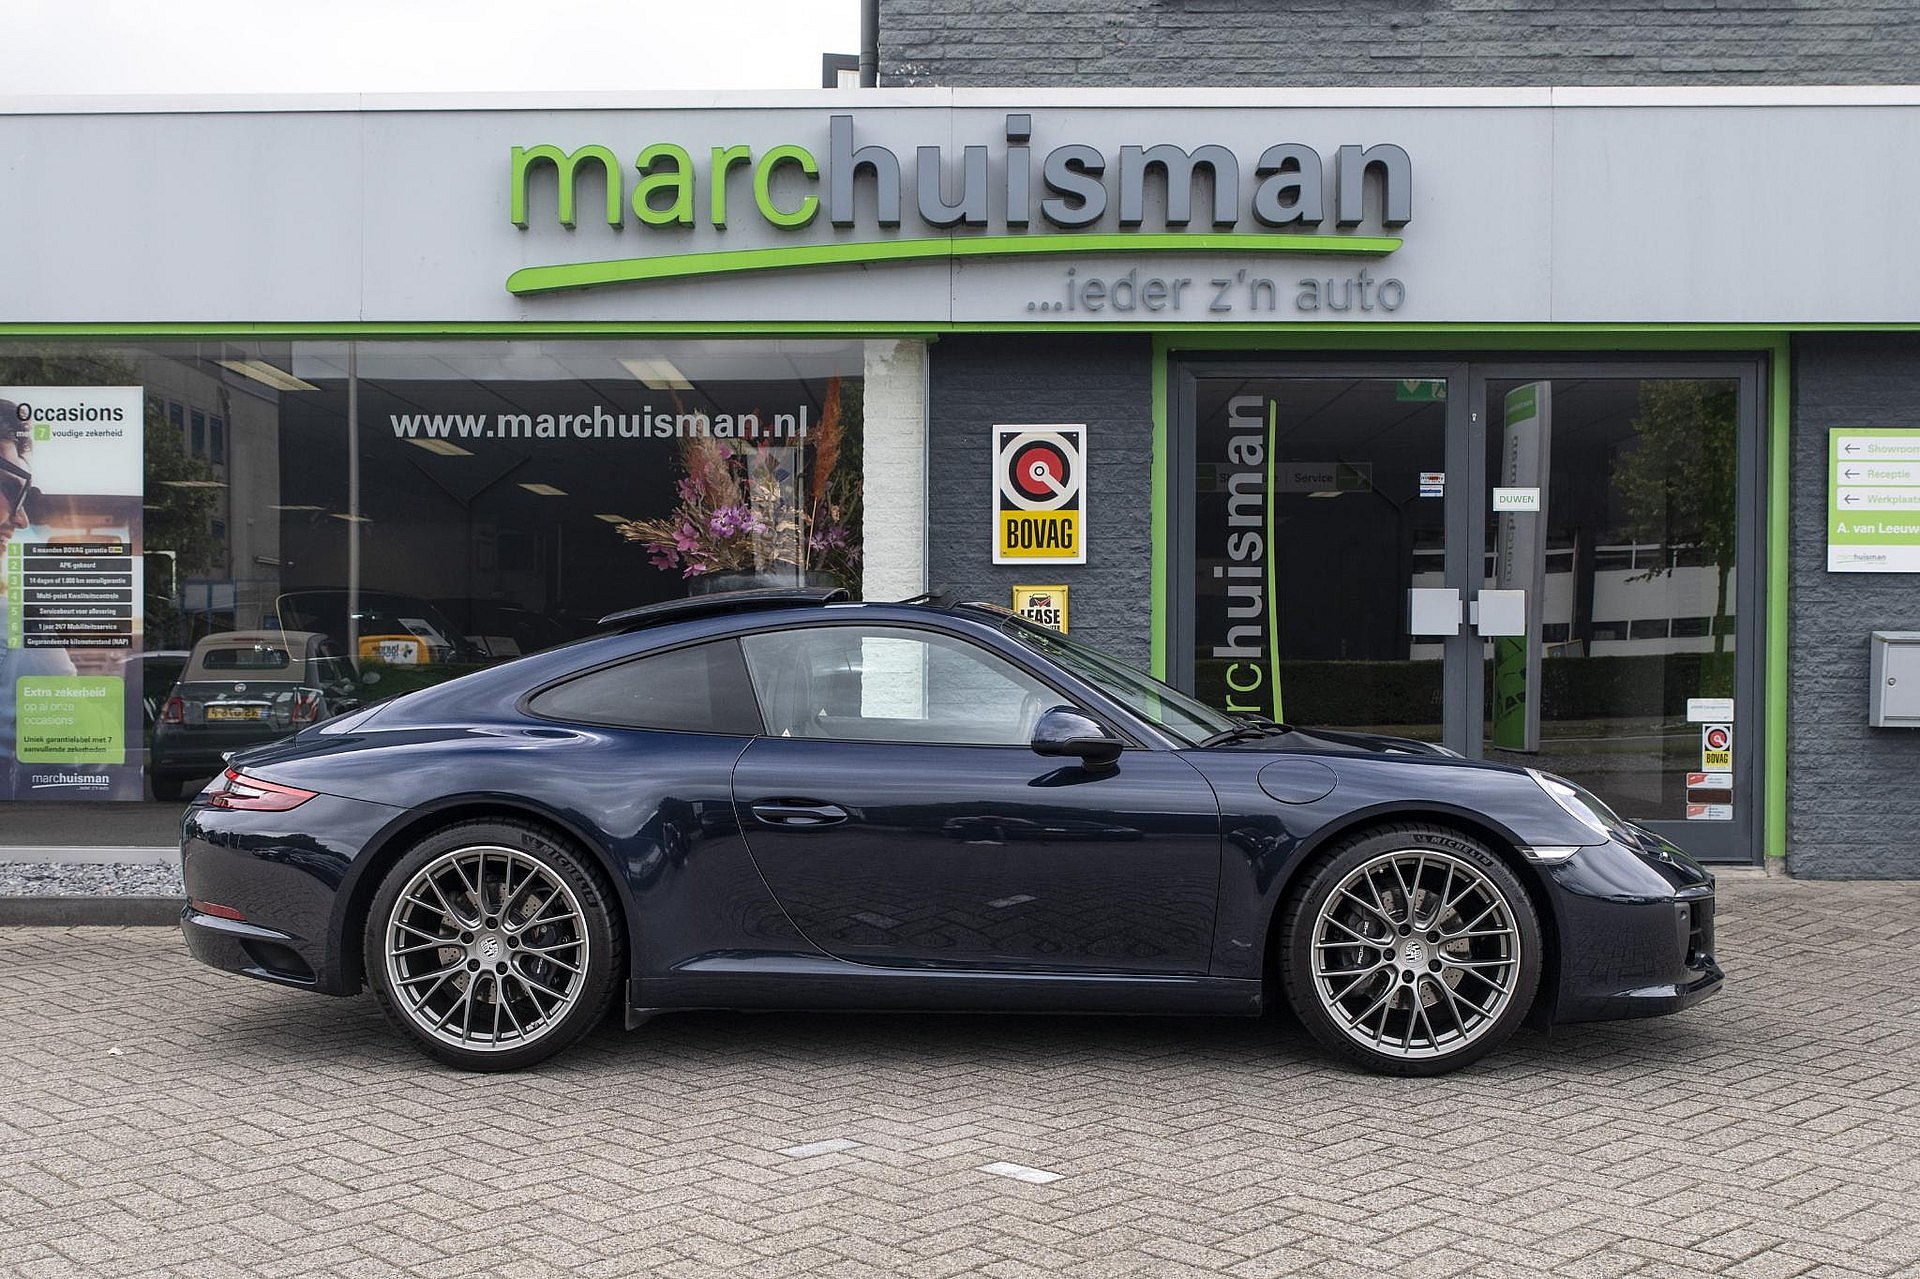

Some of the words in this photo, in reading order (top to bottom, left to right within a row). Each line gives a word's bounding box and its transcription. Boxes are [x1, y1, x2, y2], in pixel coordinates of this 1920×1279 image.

[510, 114, 1413, 232] marchuisman
[1026, 267, 1191, 312] ...ieder
[1210, 268, 1276, 312] z'n
[1297, 266, 1406, 312] auto
[17, 402, 124, 421] Occasions
[390, 405, 808, 438] www.marchuisman.nl
[52, 428, 85, 438] voudige
[86, 428, 123, 437] zekerheid
[1294, 473, 1333, 483] Service
[1867, 470, 1911, 480] Receptie
[1499, 495, 1535, 504] DUWEN
[1837, 522, 1850, 533] A.
[1853, 524, 1875, 533] van
[1879, 522, 1920, 534] Leeuw
[1006, 518, 1073, 550] BOVAG
[1213, 396, 1264, 723] rchuisman
[23, 687, 52, 697] Extra
[55, 687, 106, 697] zekerheid
[23, 703, 36, 712] op
[50, 703, 75, 711] onze
[23, 716, 74, 725] occasions
[45, 736, 91, 744] garantielabel
[1706, 753, 1729, 764] BOVAG
[32, 773, 110, 783] marchuisman
[1430, 835, 1494, 867] MICHELIN
